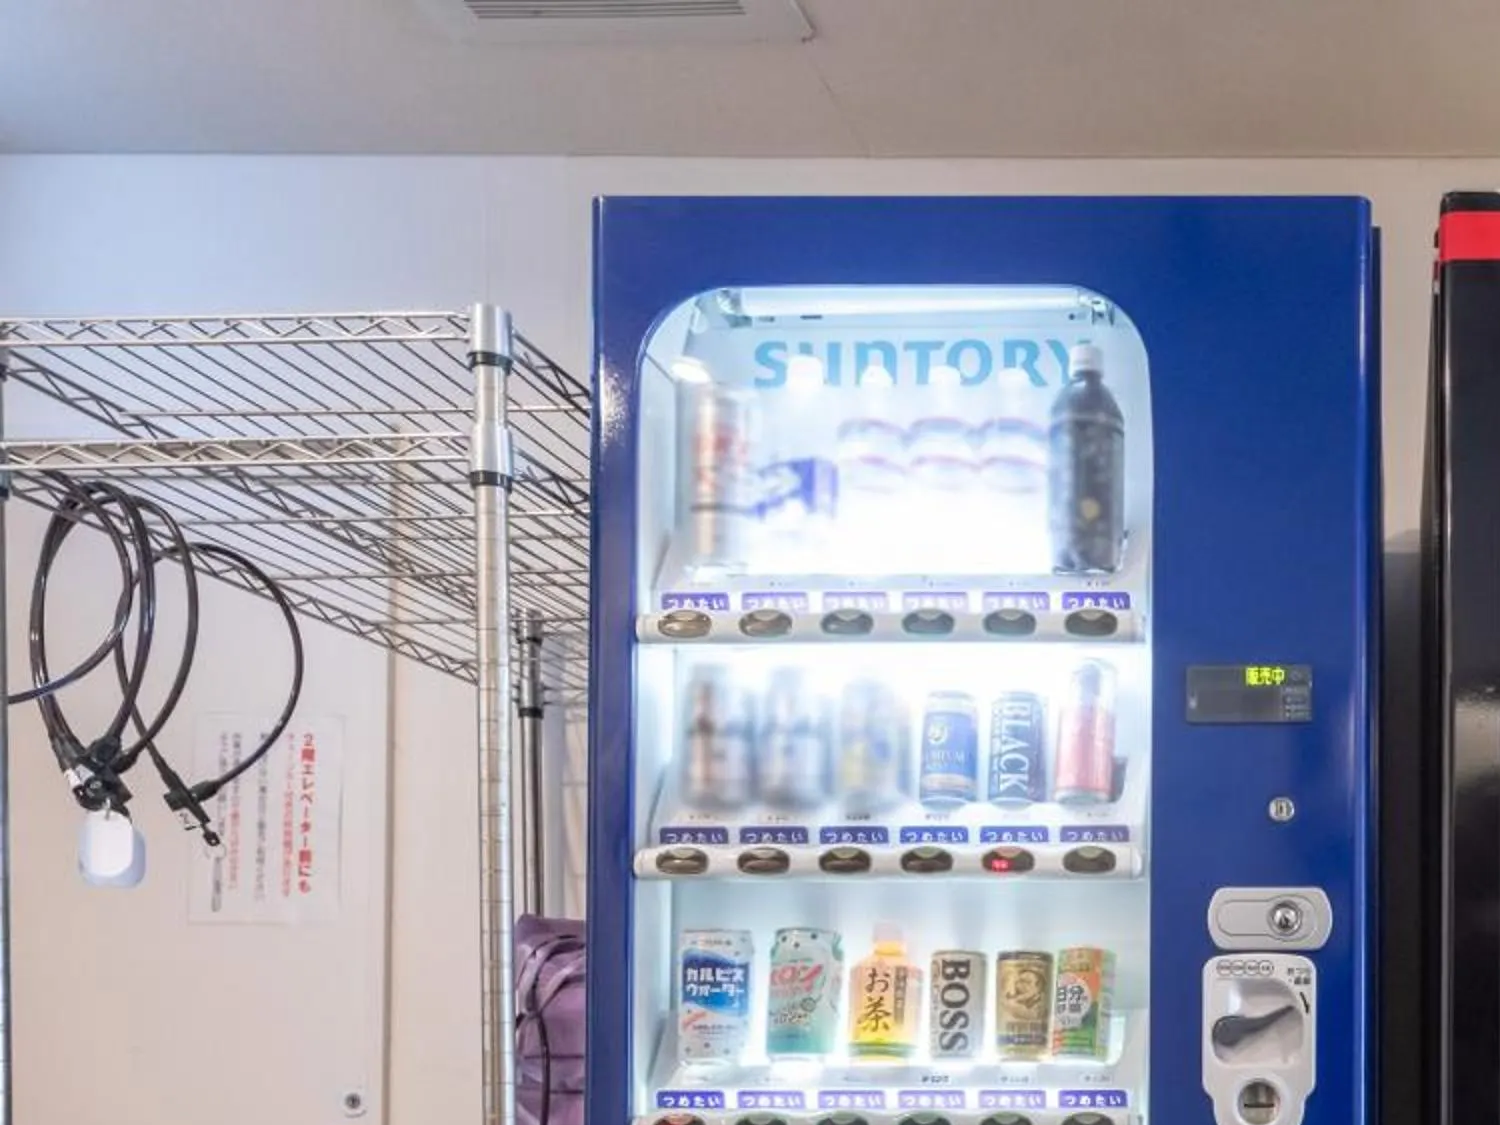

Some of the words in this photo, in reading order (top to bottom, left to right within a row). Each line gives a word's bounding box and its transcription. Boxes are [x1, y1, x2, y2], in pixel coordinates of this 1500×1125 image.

[1000, 702, 1030, 793] BLACK
[666, 832, 722, 843] つめたい
[746, 832, 802, 843] つめたい
[826, 832, 883, 843] つめたい
[906, 832, 963, 843] つめたい
[987, 832, 1043, 843] つめたい
[1067, 831, 1124, 842] つめたい
[686, 967, 745, 982] カルピス
[685, 983, 745, 997] ウォーター
[858, 967, 892, 1033] お茶
[938, 959, 971, 1051] BOSS
[663, 1096, 720, 1107] つめたい
[1067, 1096, 1122, 1107] つめたい
